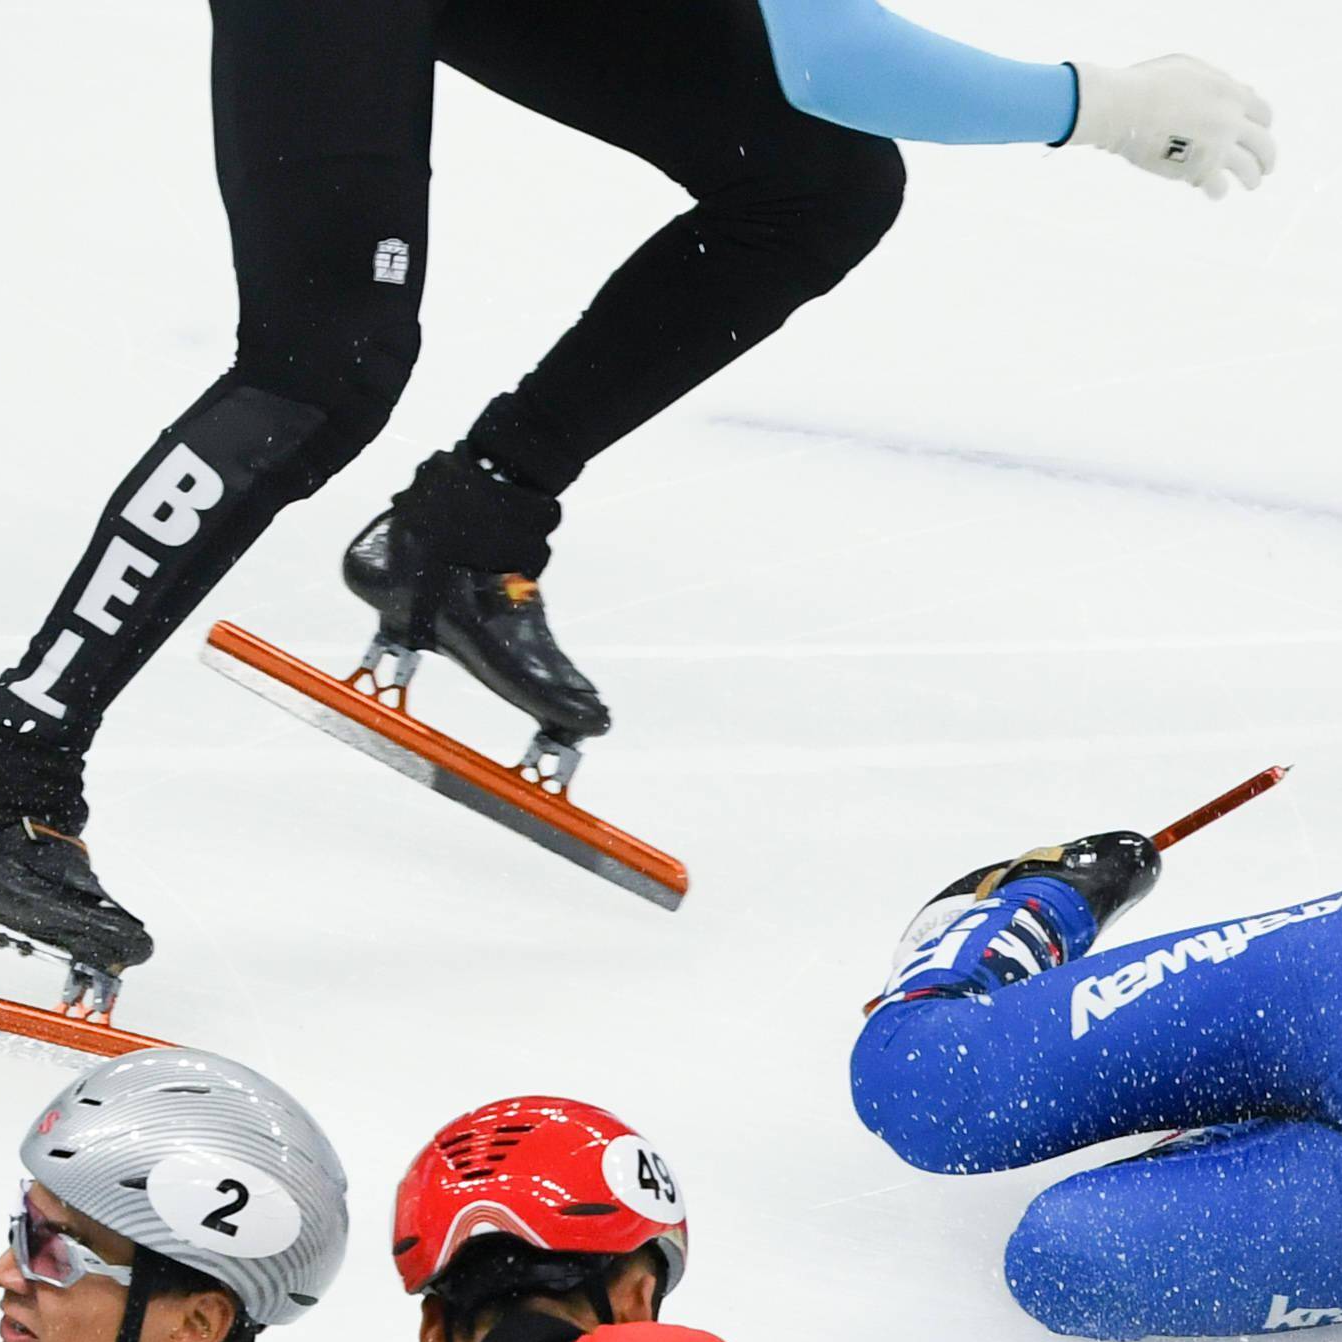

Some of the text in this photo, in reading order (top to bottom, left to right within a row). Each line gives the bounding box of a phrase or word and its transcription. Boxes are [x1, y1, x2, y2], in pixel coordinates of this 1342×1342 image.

[7, 442, 224, 720] BEL
[636, 1148, 676, 1204] 49
[200, 1178, 250, 1237] 2
